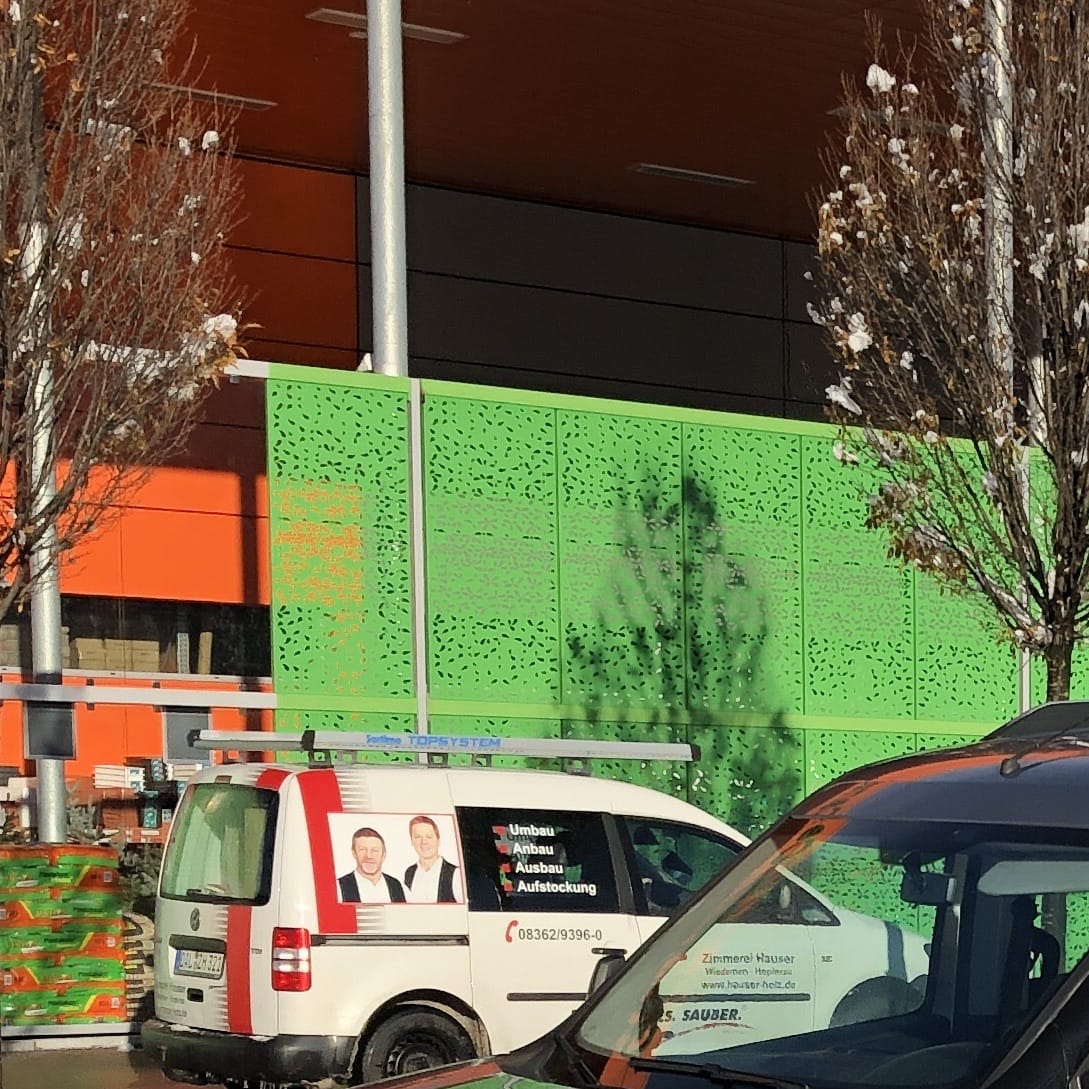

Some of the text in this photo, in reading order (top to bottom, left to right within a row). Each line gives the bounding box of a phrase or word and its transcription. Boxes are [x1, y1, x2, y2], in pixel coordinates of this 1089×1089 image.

[408, 735, 502, 748] TOPSYSTEM
[509, 823, 556, 837] Umbau
[513, 842, 555, 856] Anbau
[515, 861, 565, 874] Ausbau
[517, 880, 597, 897] Aufstockung
[518, 928, 603, 941] 08362/9396-0
[702, 952, 796, 965] Zimmerei Hauser
[682, 1008, 742, 1022] SAUBER.
